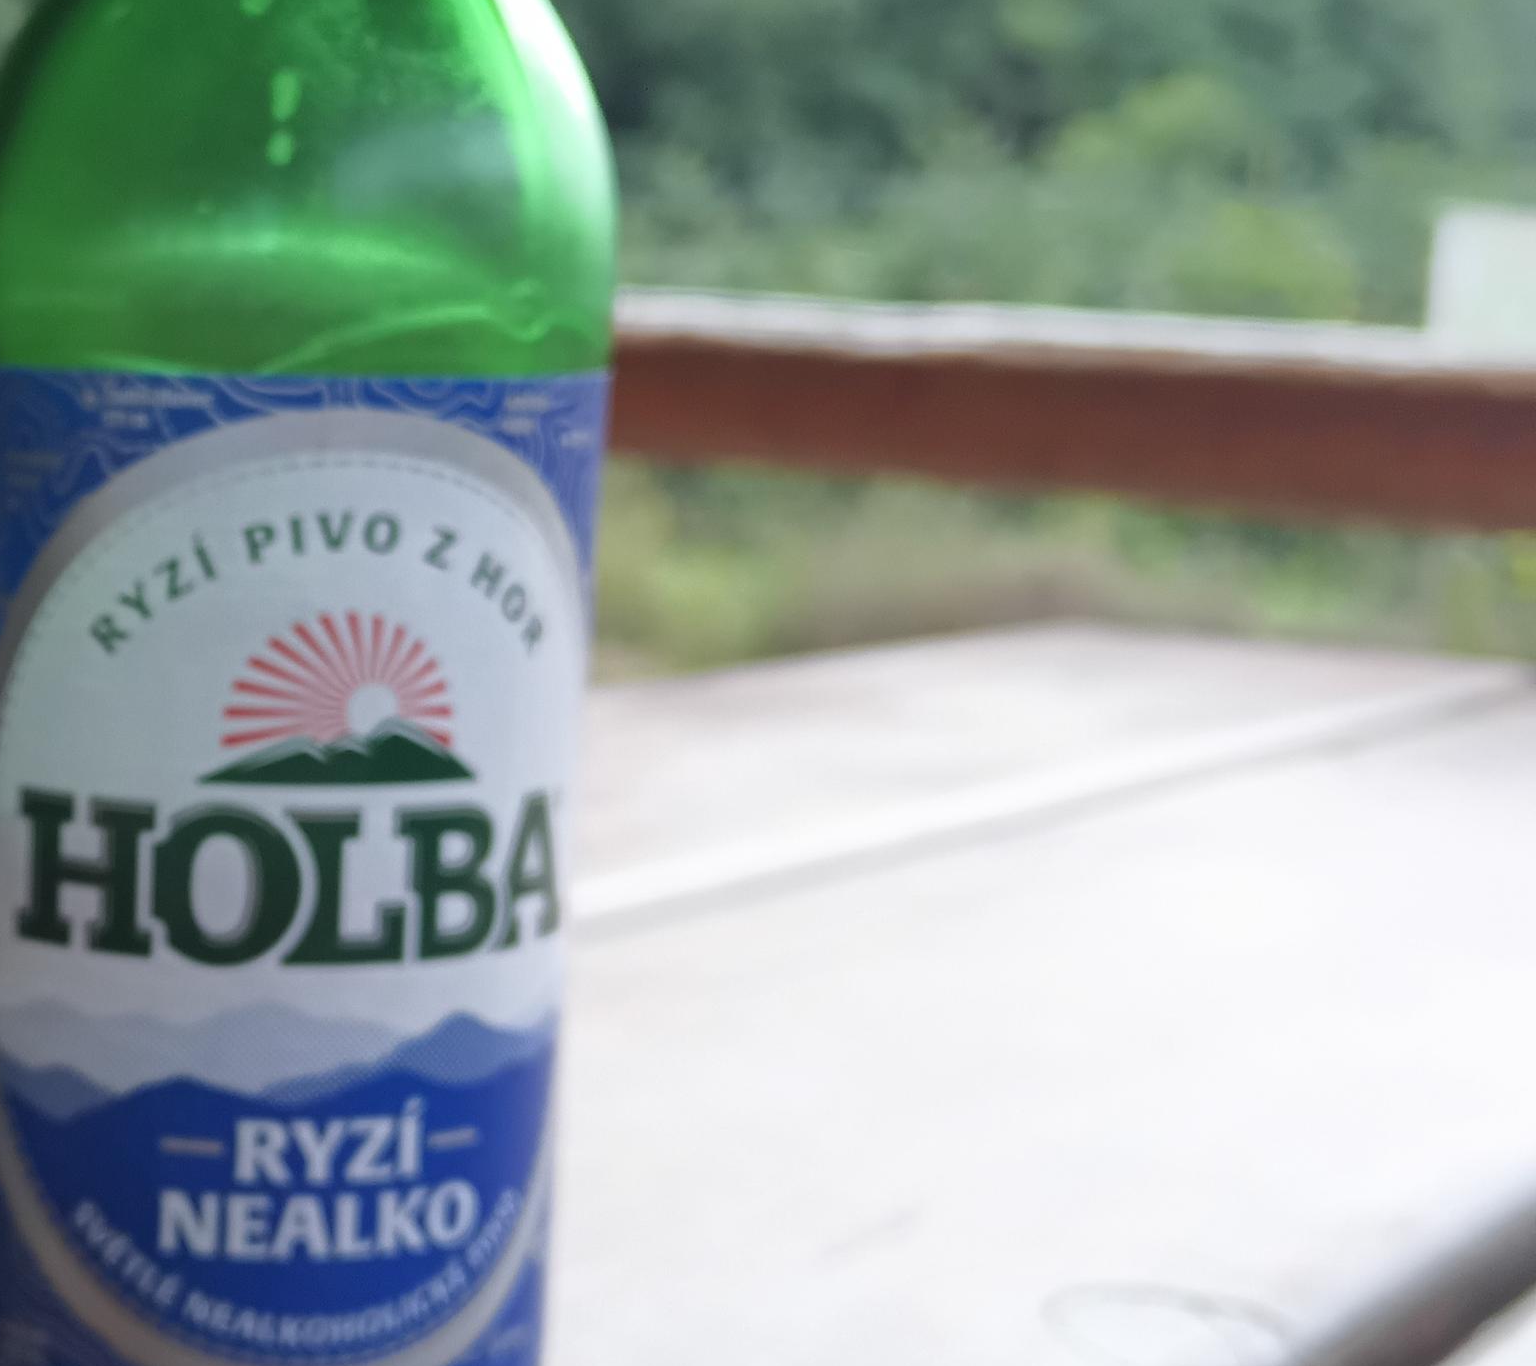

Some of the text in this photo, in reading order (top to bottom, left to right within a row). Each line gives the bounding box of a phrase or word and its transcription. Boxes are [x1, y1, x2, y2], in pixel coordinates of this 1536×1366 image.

[88, 510, 545, 655] RYZÍ PIVO Z HOR
[17, 787, 560, 966] HOLBA
[232, 1095, 425, 1184] RYZÍ
[156, 1180, 480, 1261] NEALKO
